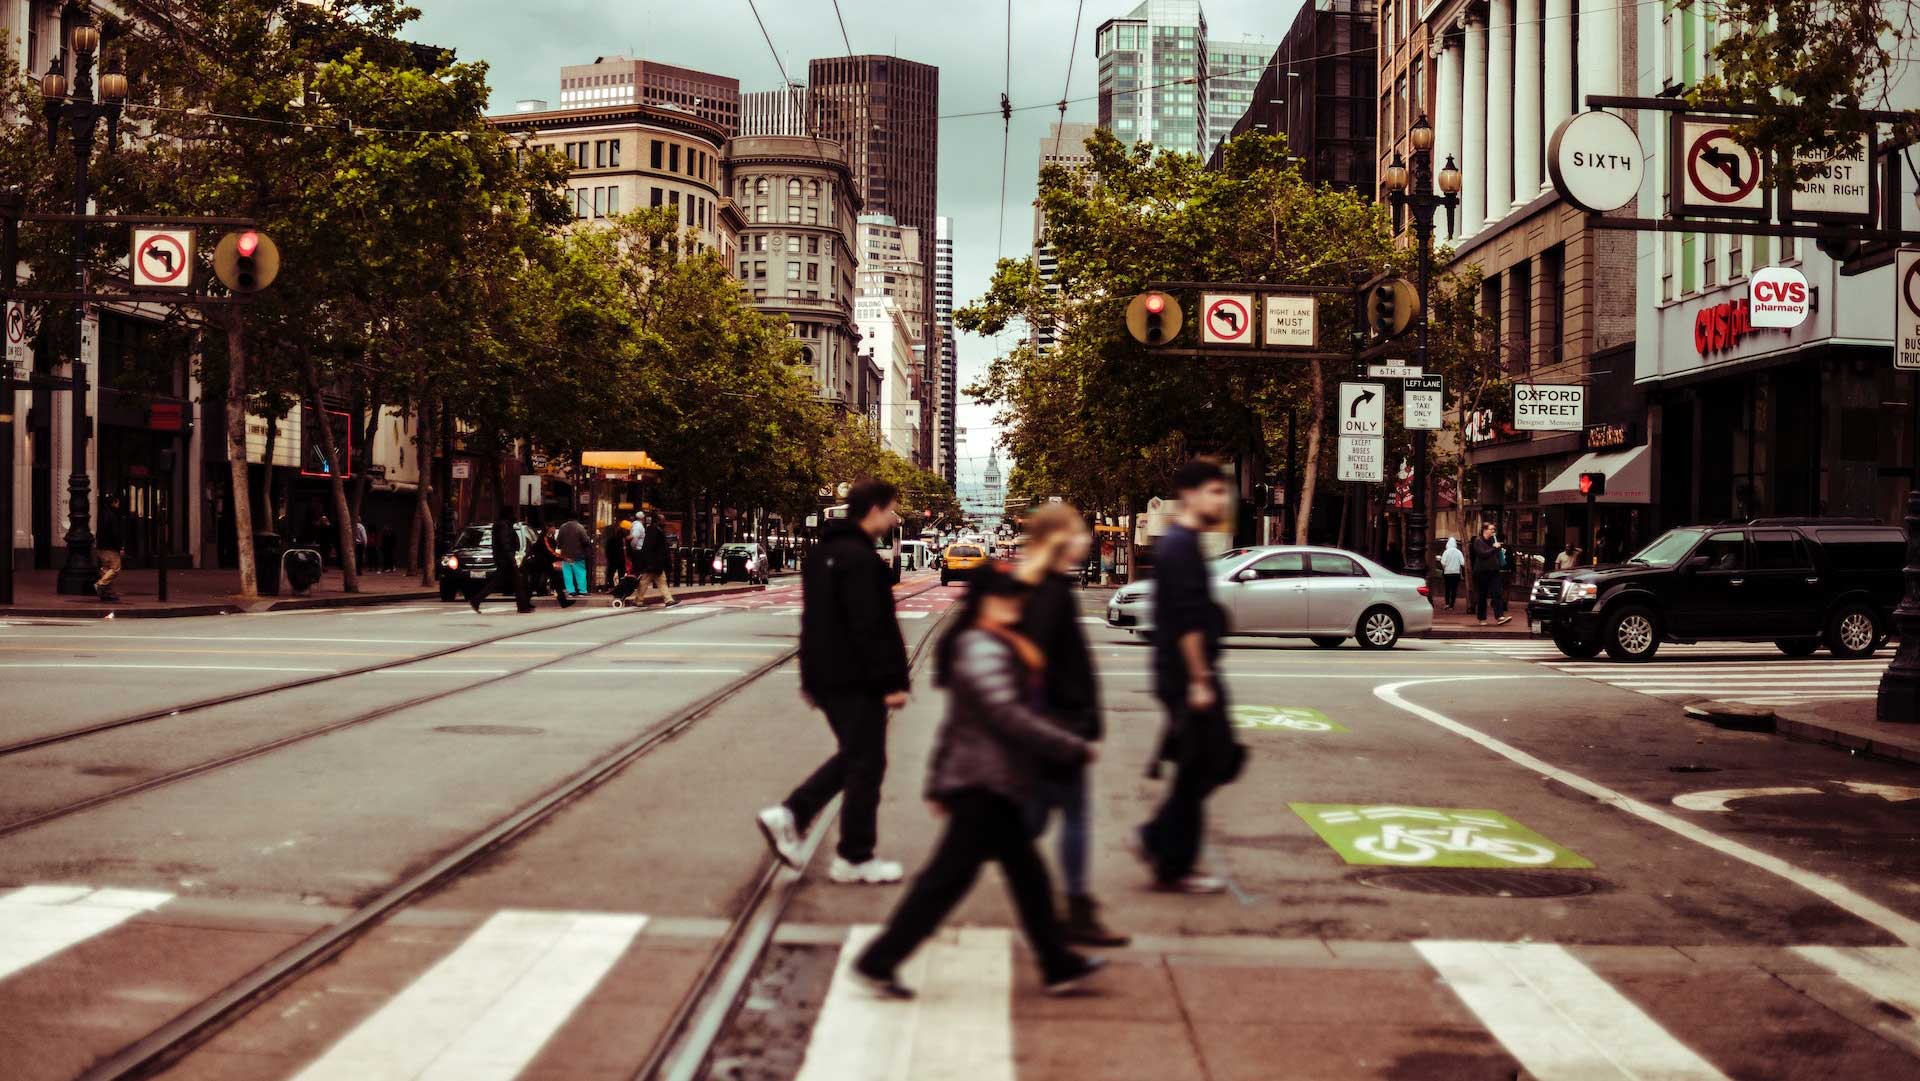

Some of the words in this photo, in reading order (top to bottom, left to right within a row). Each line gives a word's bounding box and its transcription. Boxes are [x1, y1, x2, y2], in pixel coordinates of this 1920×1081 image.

[1833, 184, 1865, 196] RIGHT
[1754, 281, 1806, 303] CVS
[1269, 308, 1288, 316] RIGHT
[1754, 303, 1804, 313] pharmacy
[1277, 318, 1303, 327] MUST
[1270, 327, 1287, 335] TURN
[1402, 368, 1412, 376] ST
[1405, 380, 1421, 388] LEFT
[1422, 380, 1441, 388] LANE
[1412, 394, 1426, 402] BUS
[1517, 390, 1581, 402] OXFORD
[1519, 404, 1579, 416] STREET
[1345, 421, 1377, 432] ONLY
[1352, 447, 1371, 455] BUSES
[1348, 455, 1374, 463] BICYCLES
[1353, 463, 1369, 471] TAXIS
